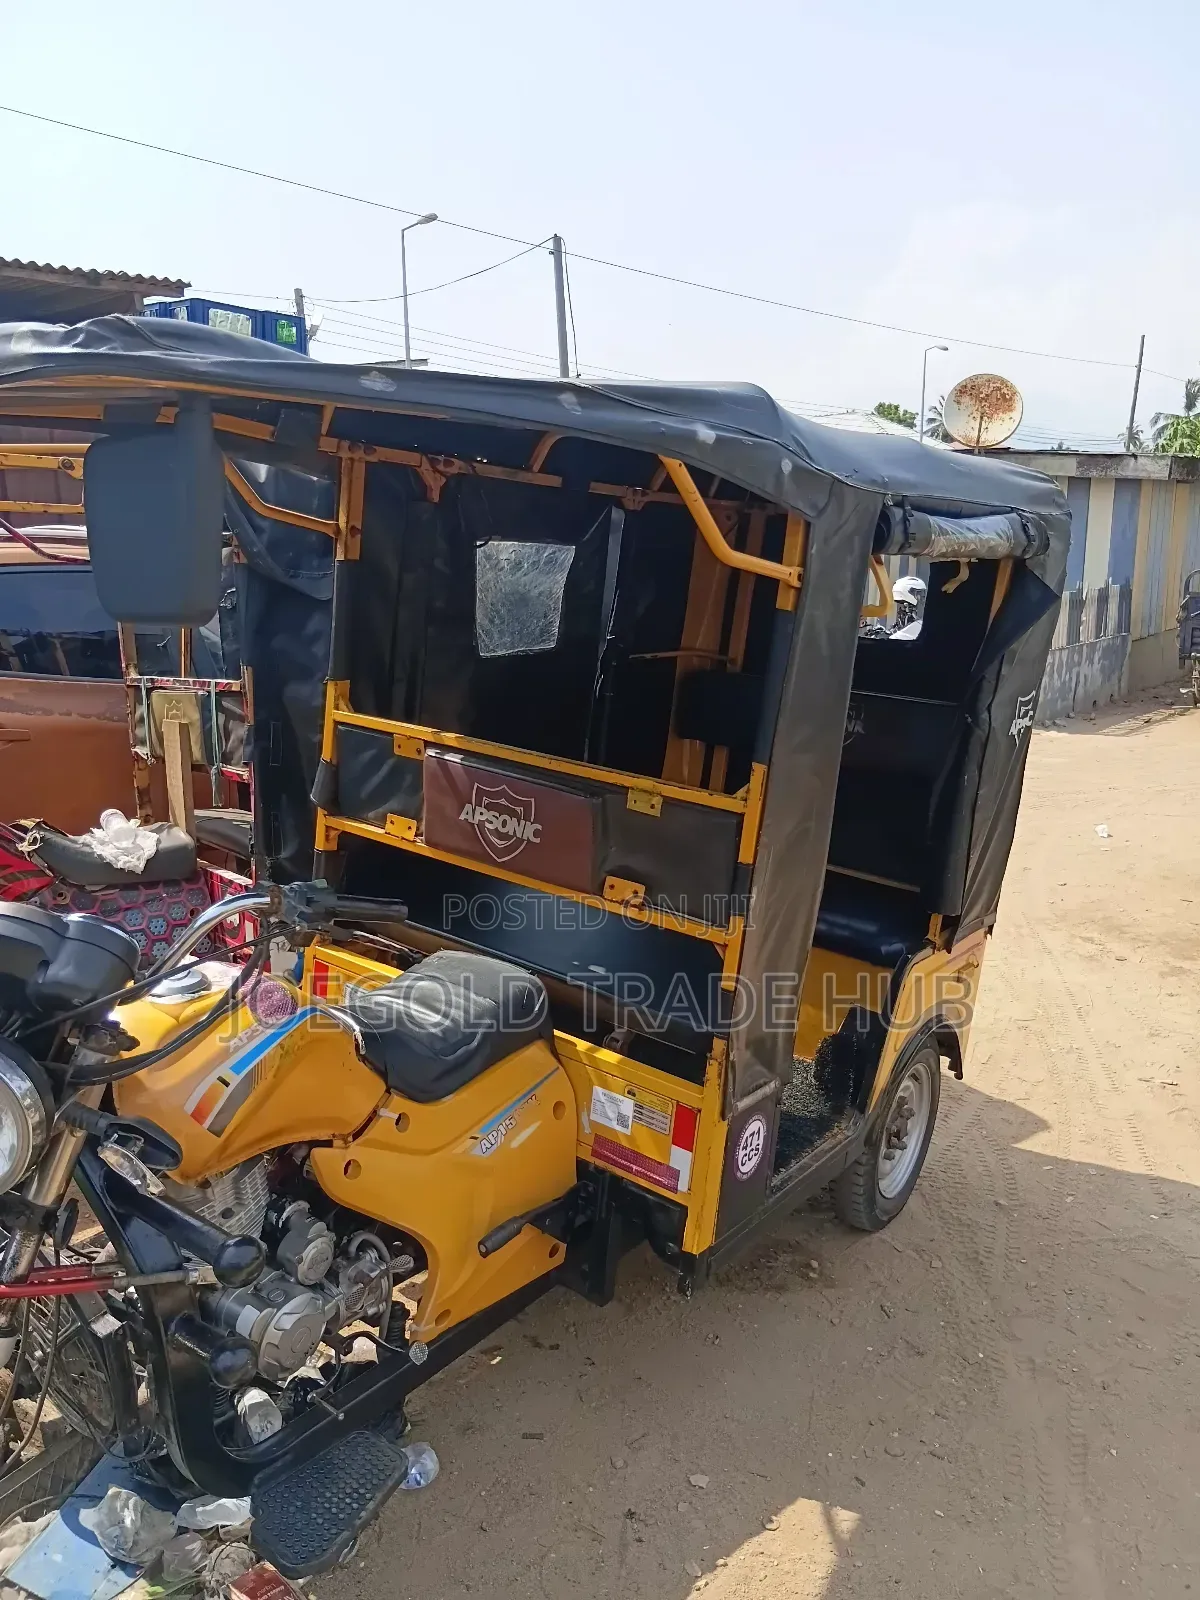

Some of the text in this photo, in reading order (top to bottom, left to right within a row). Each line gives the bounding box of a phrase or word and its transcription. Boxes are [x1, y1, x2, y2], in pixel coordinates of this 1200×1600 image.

[458, 803, 542, 844] APSONIC
[741, 1126, 760, 1151] 471
[741, 1143, 760, 1167] CCS
